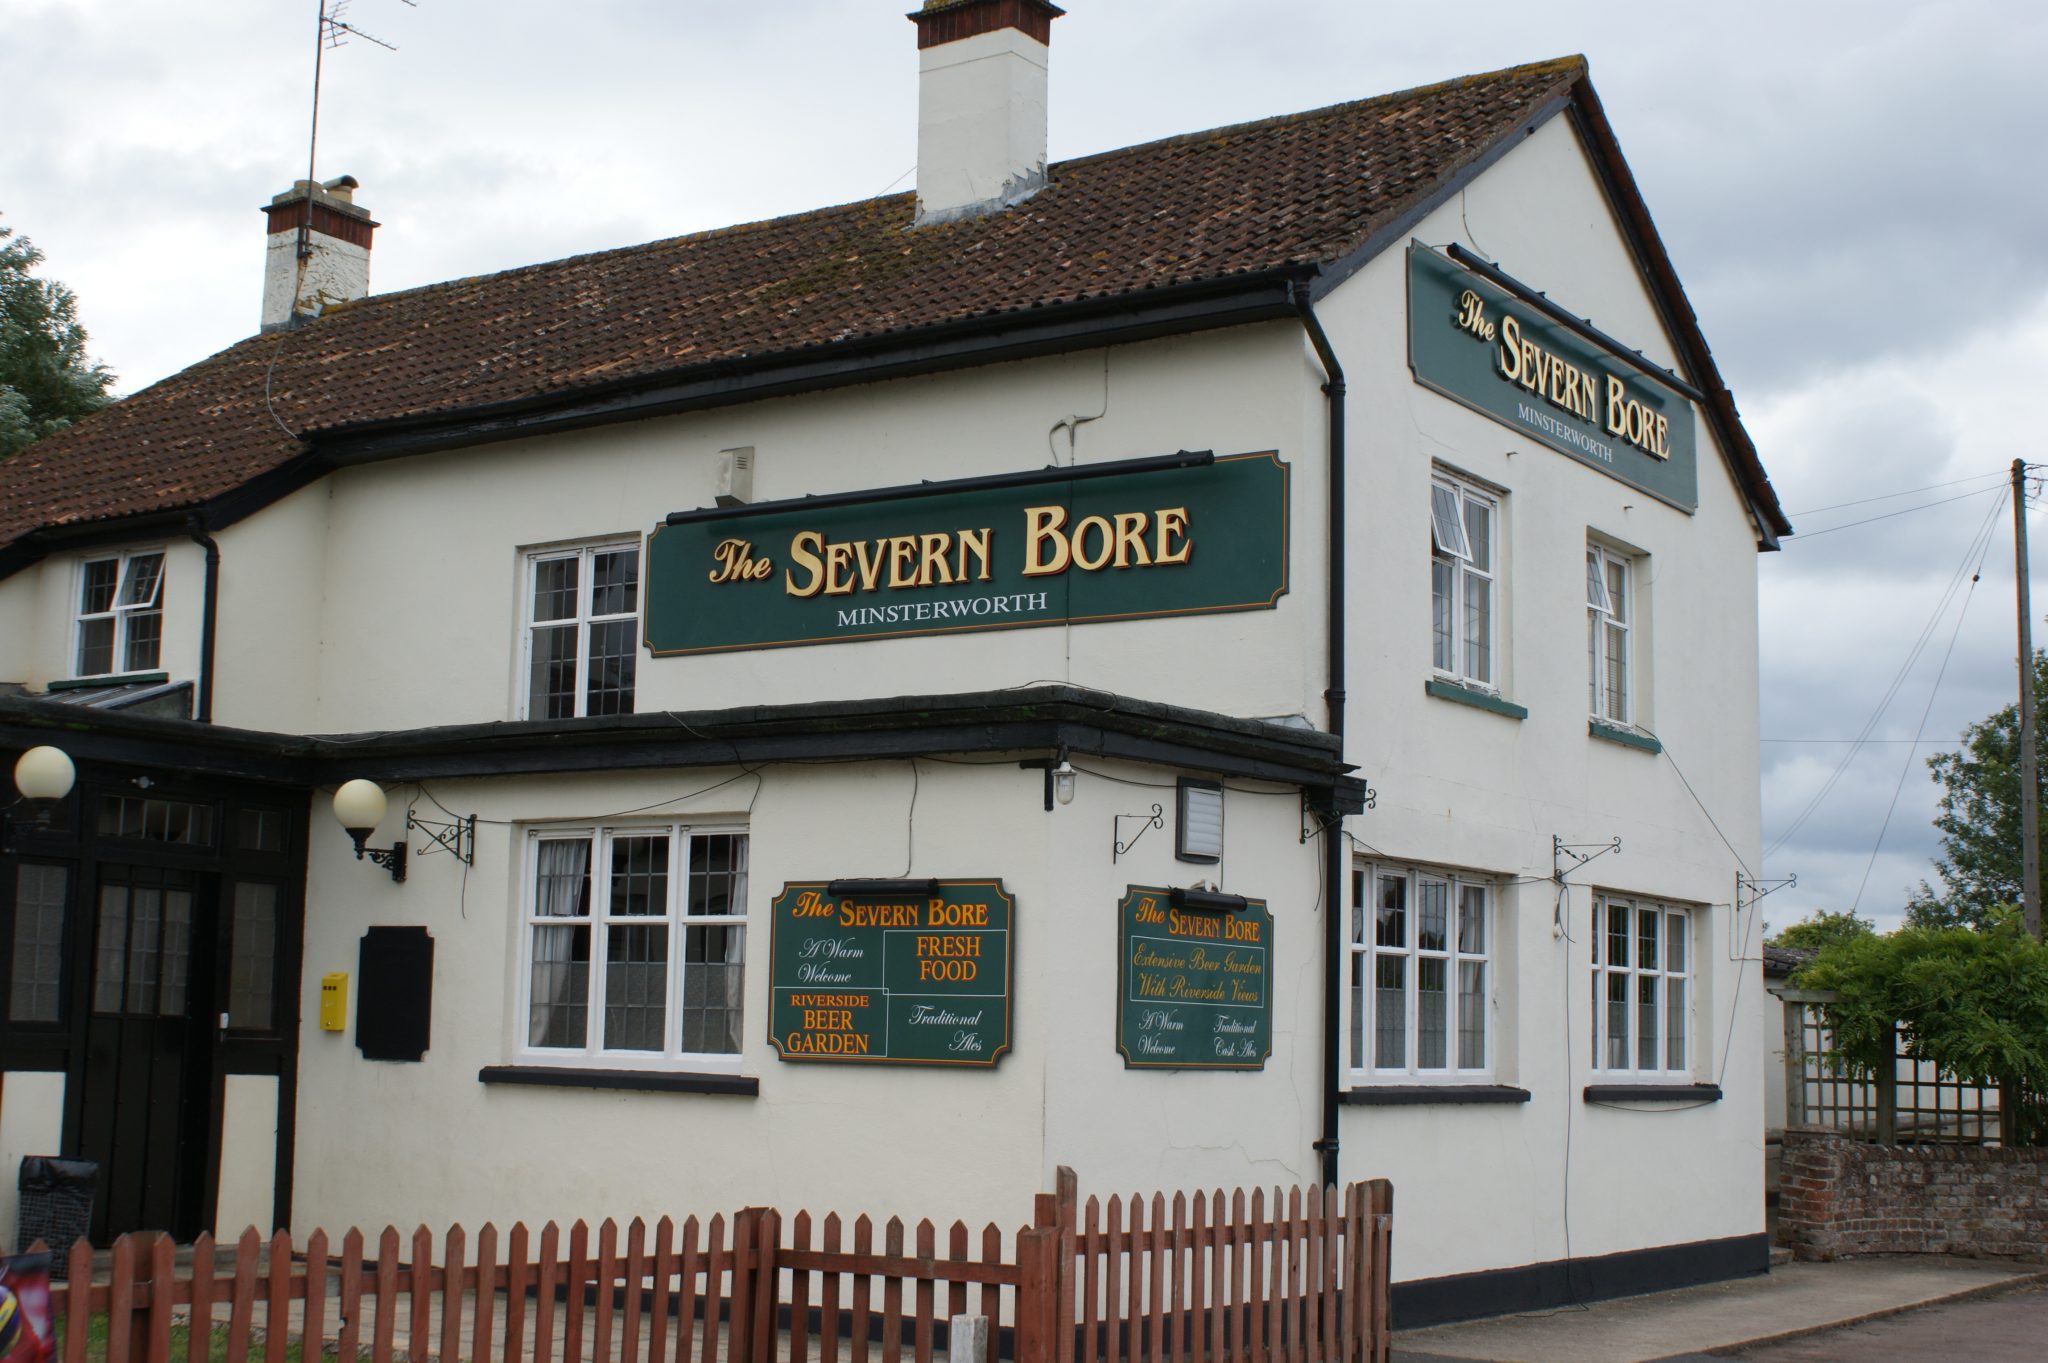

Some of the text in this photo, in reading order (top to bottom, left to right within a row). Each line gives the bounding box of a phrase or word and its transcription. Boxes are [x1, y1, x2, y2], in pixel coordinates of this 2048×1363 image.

[1457, 290, 1670, 460] The SEVERN BORE
[1518, 403, 1612, 462] MINSTERWORTH
[708, 505, 1193, 599] The SEVERN BORE
[837, 593, 1048, 627] MINSTERWORTH
[792, 891, 989, 927] The SEVERN BORE
[1135, 897, 1260, 942] The SEVERN BORE
[799, 937, 864, 958] A Warm
[917, 936, 981, 957] FRESH
[1133, 943, 1262, 975] Extensive Beer Garden
[798, 961, 851, 983] Welcome
[920, 960, 976, 981] FOOD
[1138, 972, 1258, 1002] With Riverside Views
[790, 994, 870, 1007] RIVERSIDE
[803, 1010, 853, 1030] BEER
[908, 1005, 983, 1026] Traditional
[1138, 1009, 1184, 1031] A Warm
[1213, 1014, 1257, 1034] Traditional
[787, 1032, 870, 1054] GARDEN
[1137, 1032, 1176, 1055] Welcome
[1213, 1036, 1235, 1057] Cask
